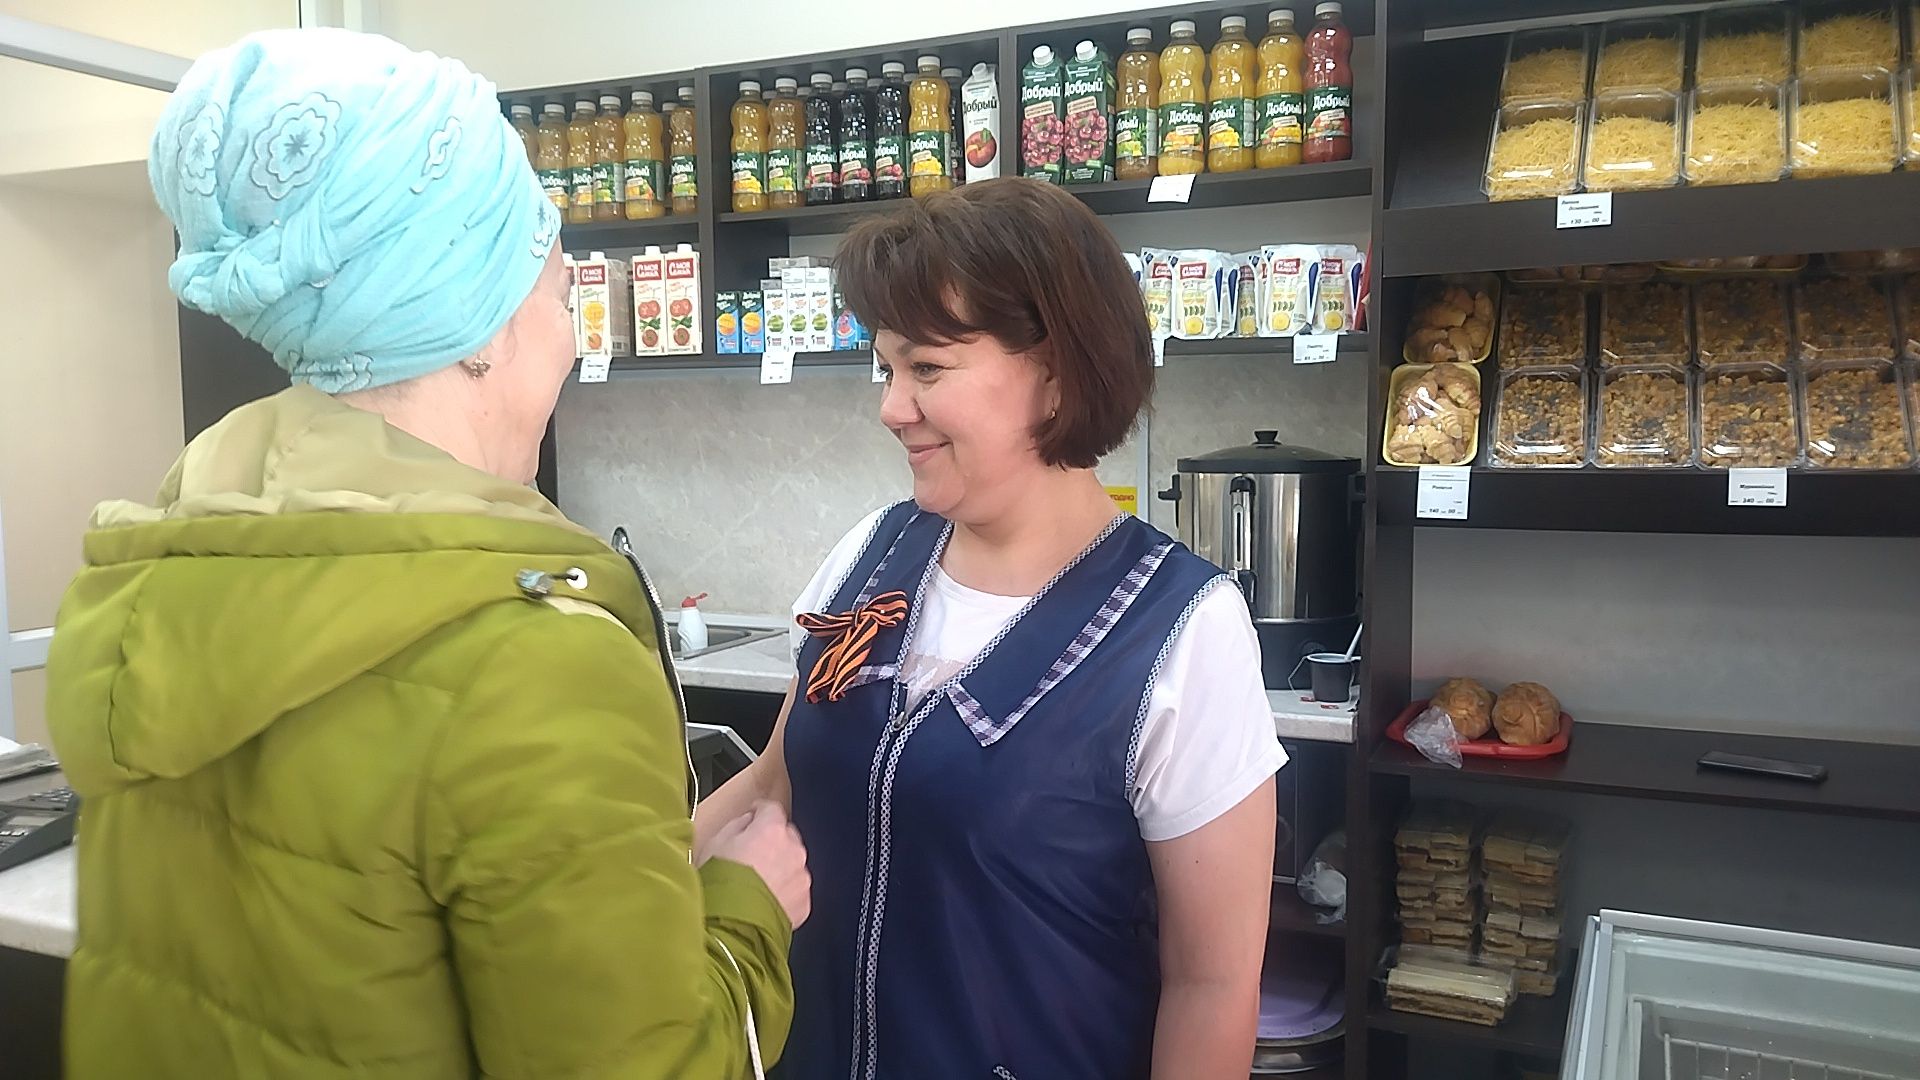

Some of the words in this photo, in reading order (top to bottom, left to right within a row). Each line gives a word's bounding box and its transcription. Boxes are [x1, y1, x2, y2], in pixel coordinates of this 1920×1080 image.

[1022, 83, 1061, 102] Добрый
[1064, 77, 1104, 98] Добрый
[962, 96, 998, 115] Добрый
[1265, 99, 1302, 118] Добрый
[1312, 93, 1351, 111] Добрый
[1168, 109, 1204, 124] Добрый
